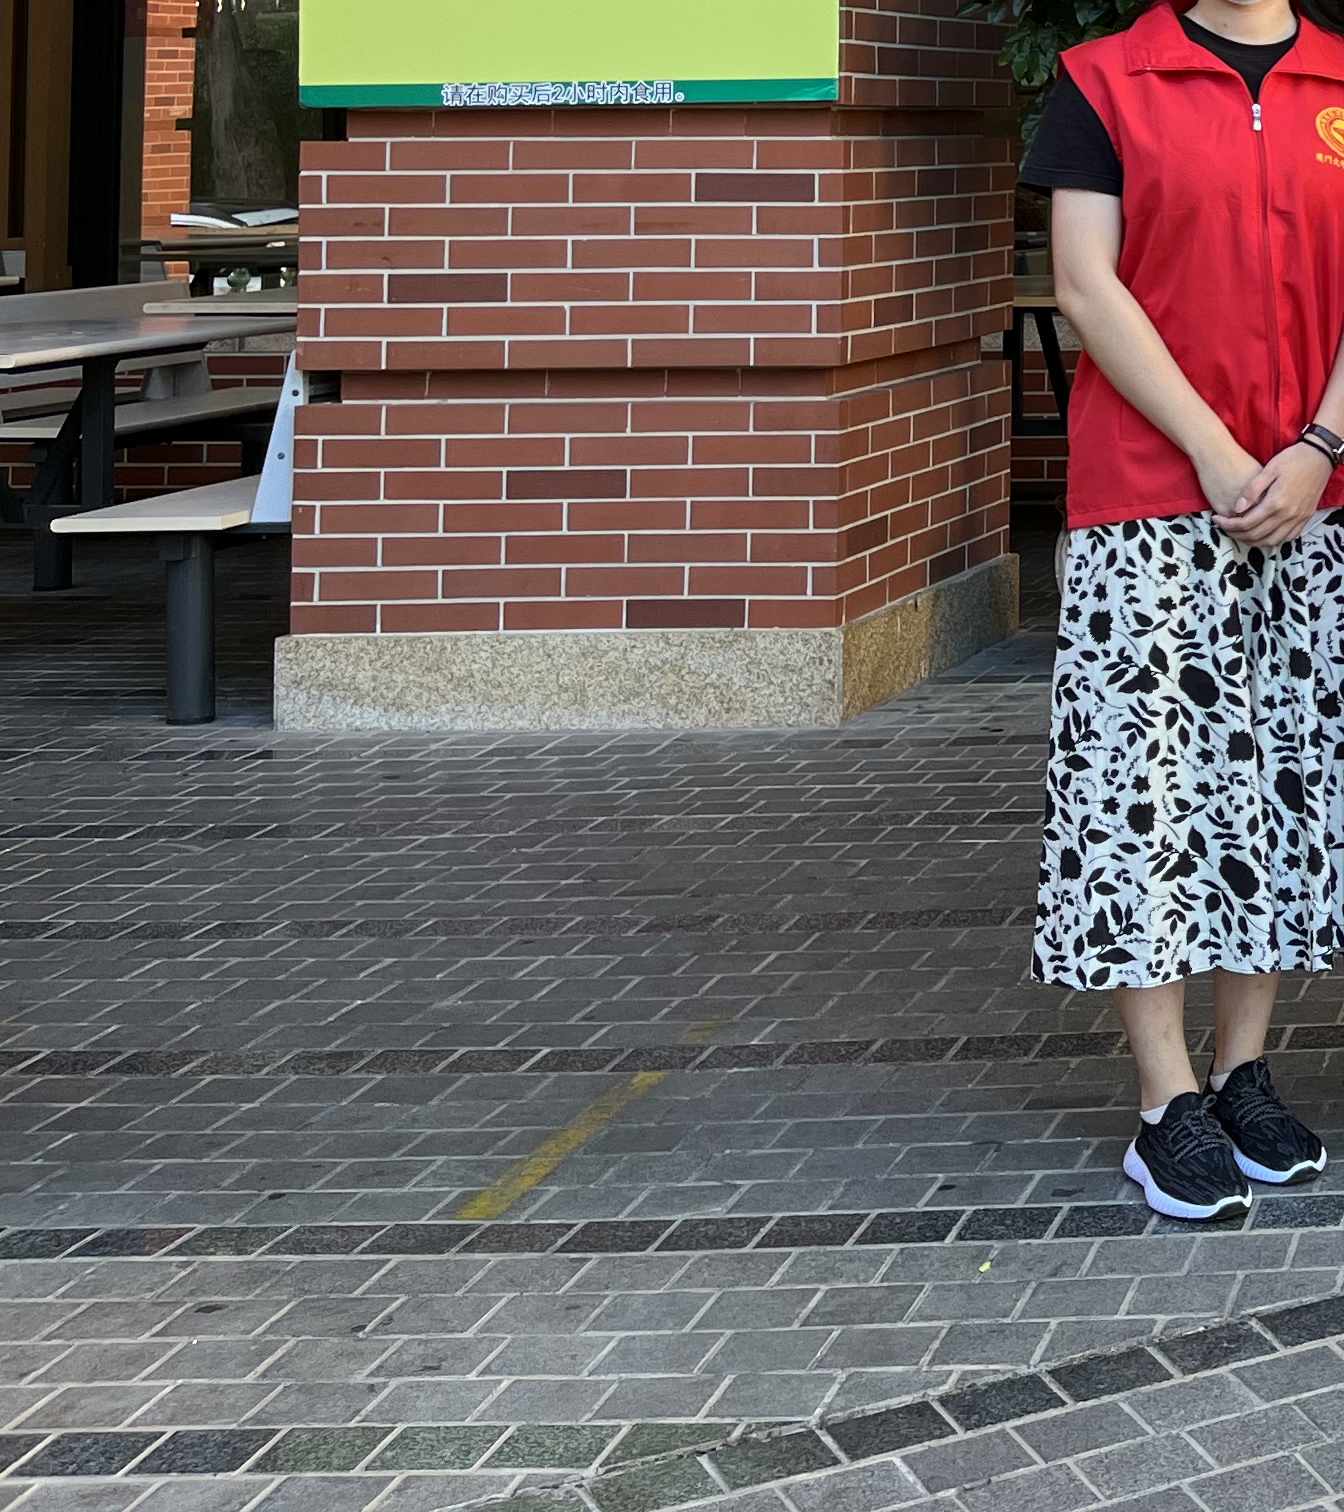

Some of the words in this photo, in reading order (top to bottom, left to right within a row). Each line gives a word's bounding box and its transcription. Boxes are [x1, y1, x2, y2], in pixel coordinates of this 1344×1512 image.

[441, 80, 685, 107] 请在购买后2小时内食用。
